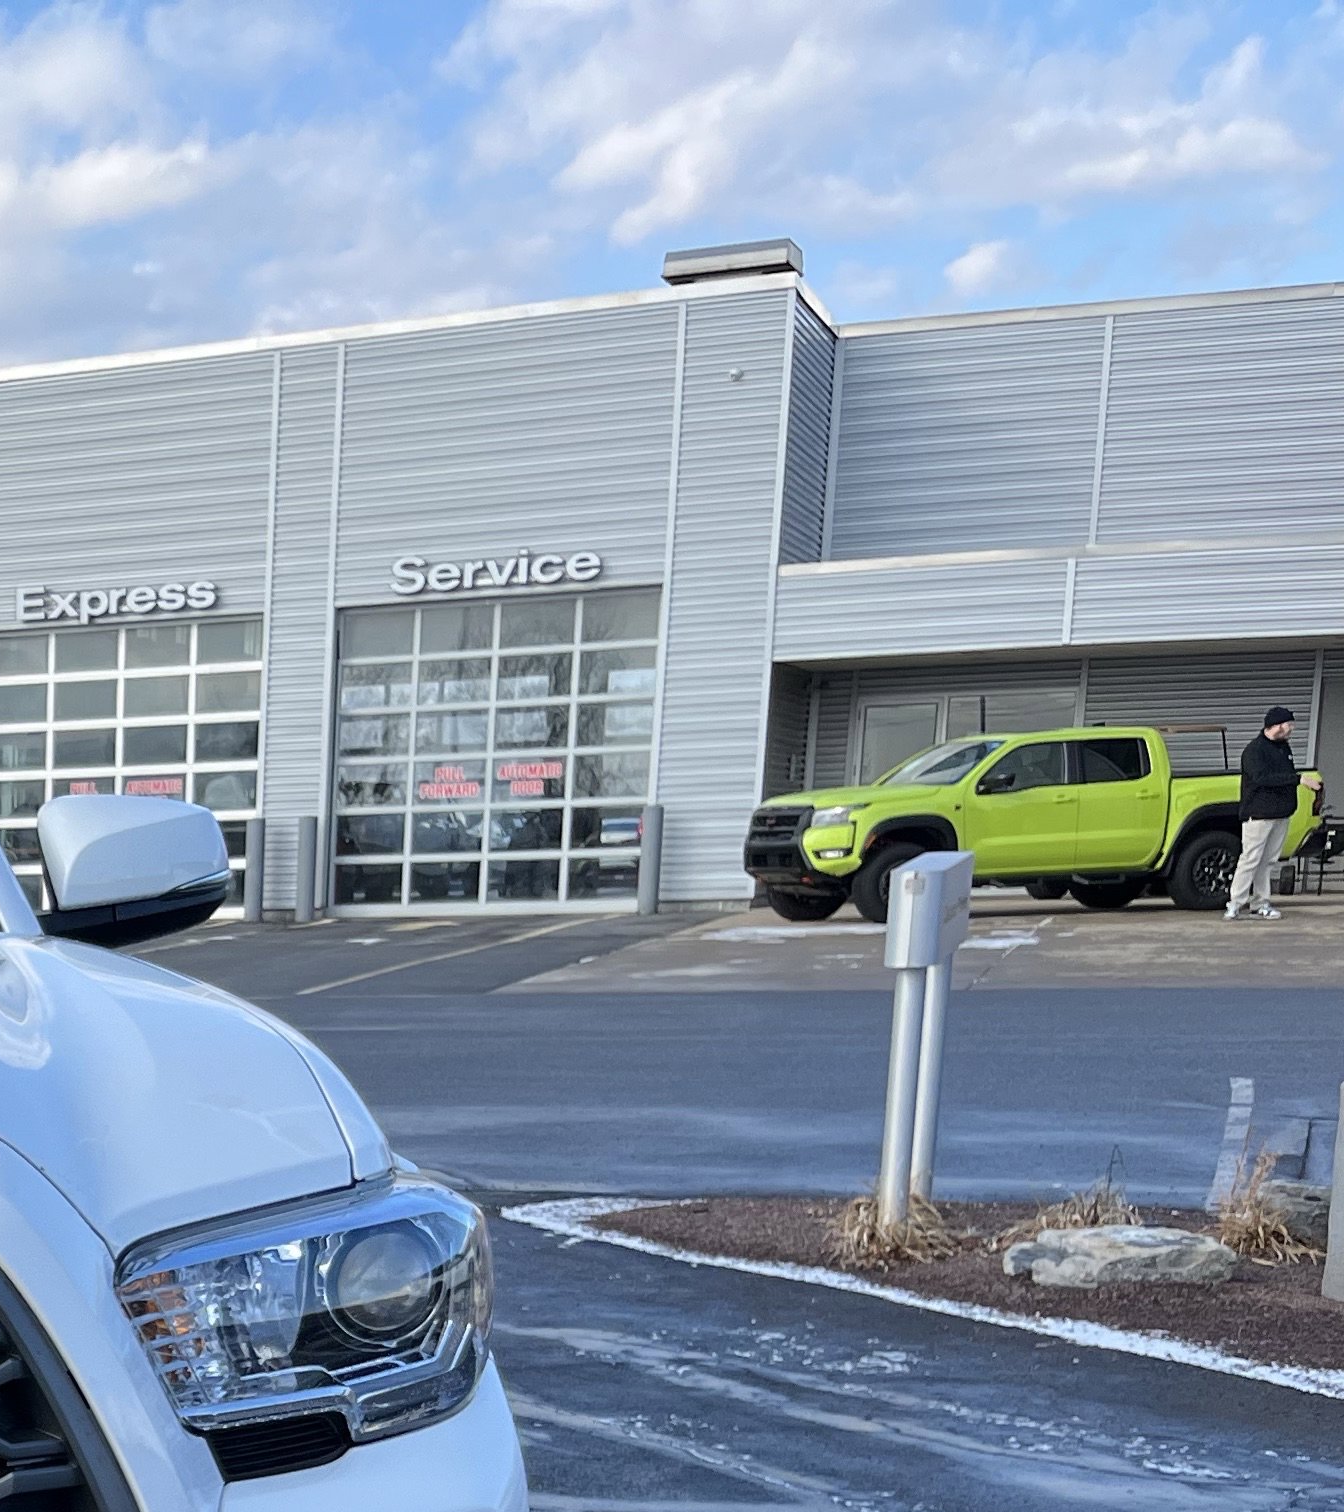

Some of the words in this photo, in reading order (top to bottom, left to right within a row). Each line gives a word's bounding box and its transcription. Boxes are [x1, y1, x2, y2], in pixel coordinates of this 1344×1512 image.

[389, 549, 602, 595] Service
[15, 580, 217, 625] Express
[434, 767, 465, 782] PULL
[497, 762, 562, 780] AUTOMATIC
[419, 782, 480, 799] FORWARD
[510, 780, 544, 796] DOOR
